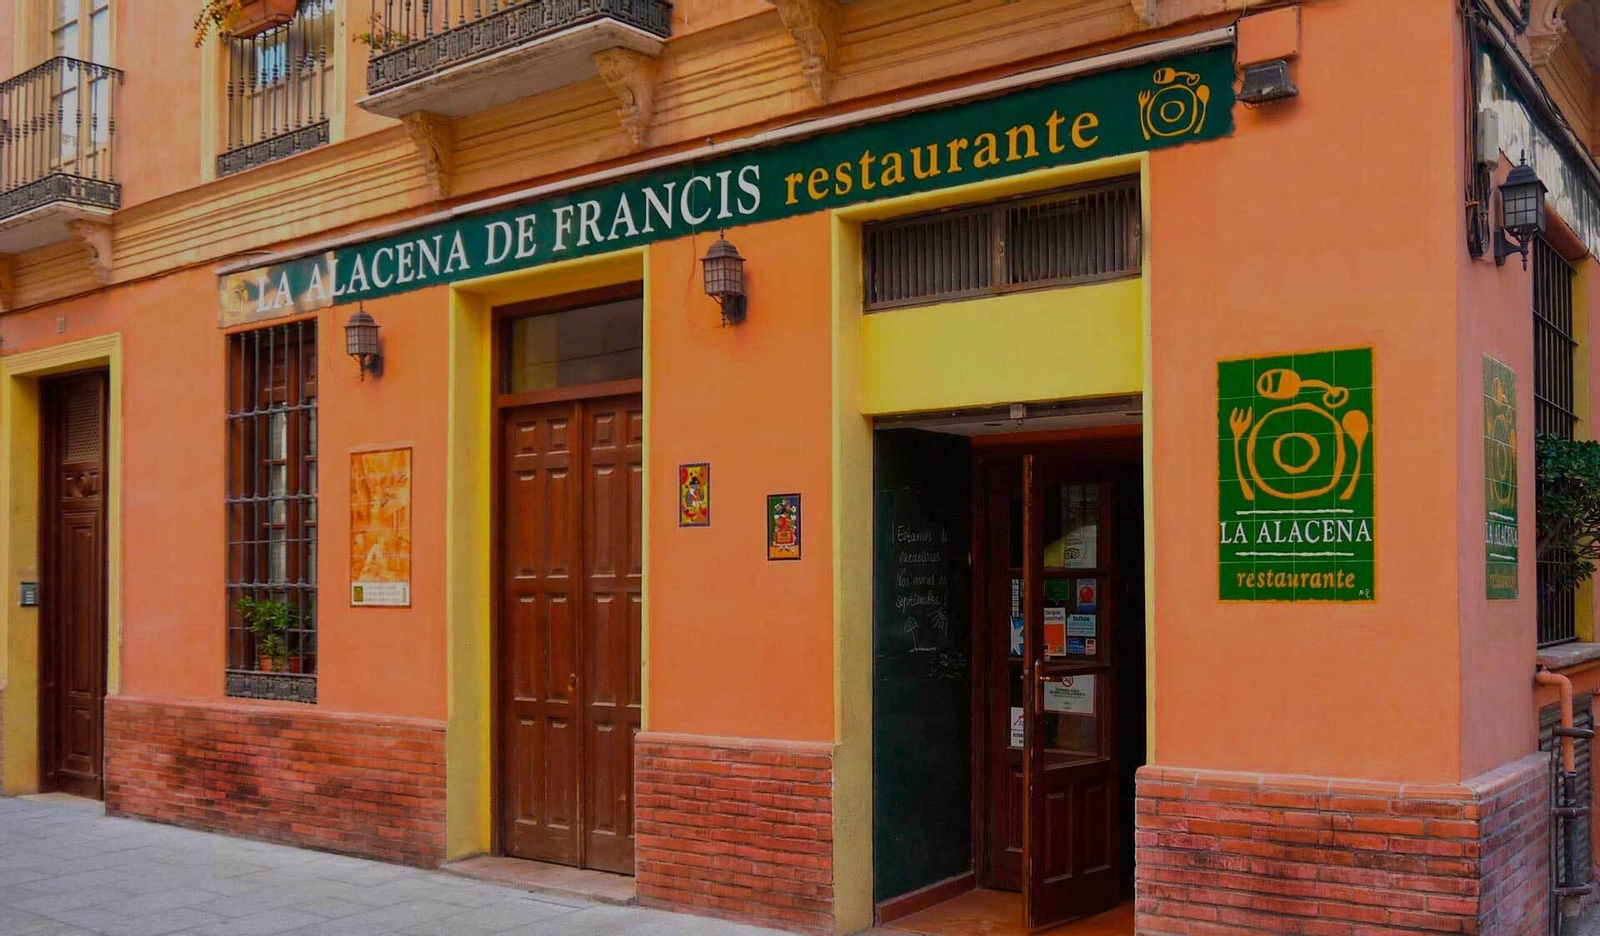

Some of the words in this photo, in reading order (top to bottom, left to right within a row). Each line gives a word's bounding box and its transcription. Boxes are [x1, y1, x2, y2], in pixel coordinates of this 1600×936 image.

[783, 108, 1100, 206] restaurante
[255, 268, 295, 313] LA
[304, 231, 469, 301] ALACENA
[485, 213, 538, 264] DE
[552, 164, 762, 251] FRANCIS
[1219, 521, 1248, 545] LA
[1255, 519, 1373, 544] ALACENA
[1237, 568, 1356, 589] restaurante
